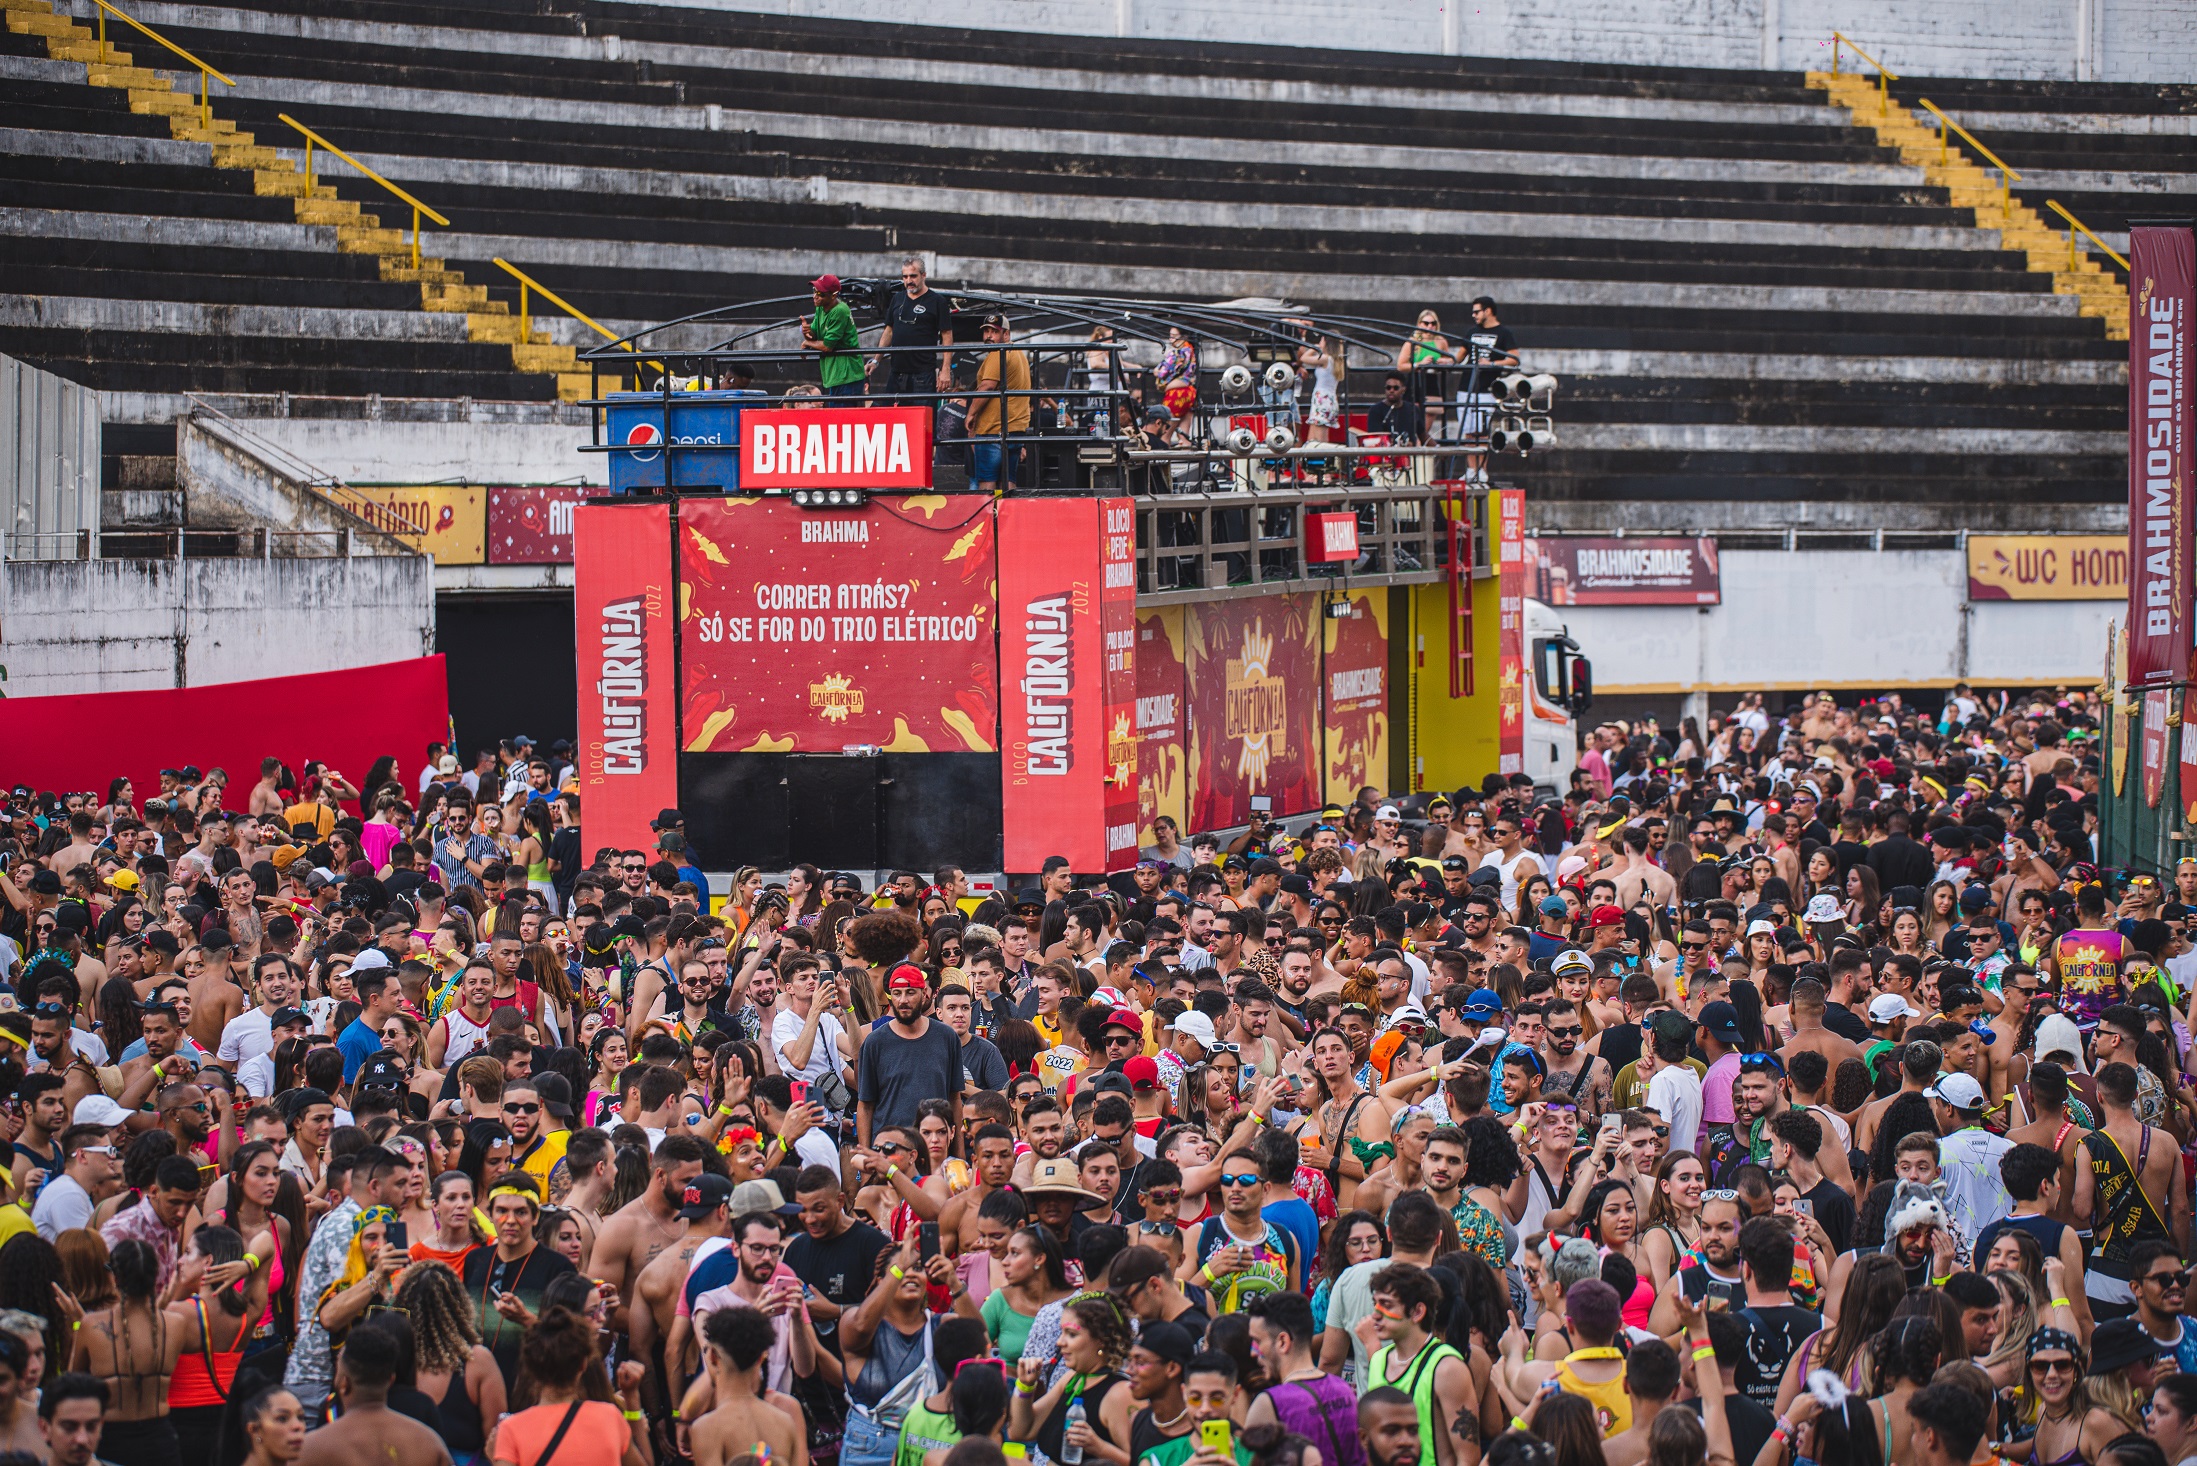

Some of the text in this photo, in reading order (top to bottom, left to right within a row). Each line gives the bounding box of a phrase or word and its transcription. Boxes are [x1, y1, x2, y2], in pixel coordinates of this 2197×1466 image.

[2174, 332, 2183, 400] BRAHMA
[2174, 402, 2182, 421] SÓ
[753, 422, 912, 475] BRAHMA
[2146, 296, 2173, 637] BRAHMOSIDADE
[801, 521, 869, 543] BRAHMA
[1107, 508, 1130, 534] BLOCO
[1110, 536, 1127, 560] PEDE
[1324, 521, 1357, 552] BRAHMA
[1105, 562, 1134, 588] BRAHMA
[1577, 549, 1693, 576] BRAHMOSIDADE
[2016, 549, 2056, 584] WC
[646, 585, 662, 618] 2022
[757, 577, 910, 609] CORRER ATRÁS?
[1072, 581, 1089, 615] 2022
[699, 610, 977, 642] SÓ SE FOR DO TRIO ELÉTRICO
[1117, 630, 1134, 648] BLOCO
[2174, 623, 2180, 633] A
[590, 741, 604, 785] BLOCO
[1013, 741, 1028, 785] BLOCO
[1110, 822, 1137, 851] BRAHMA
[1045, 1055, 1074, 1070] 2022
[1747, 1384, 1754, 1394] Só
[1756, 1384, 1771, 1394] existe
